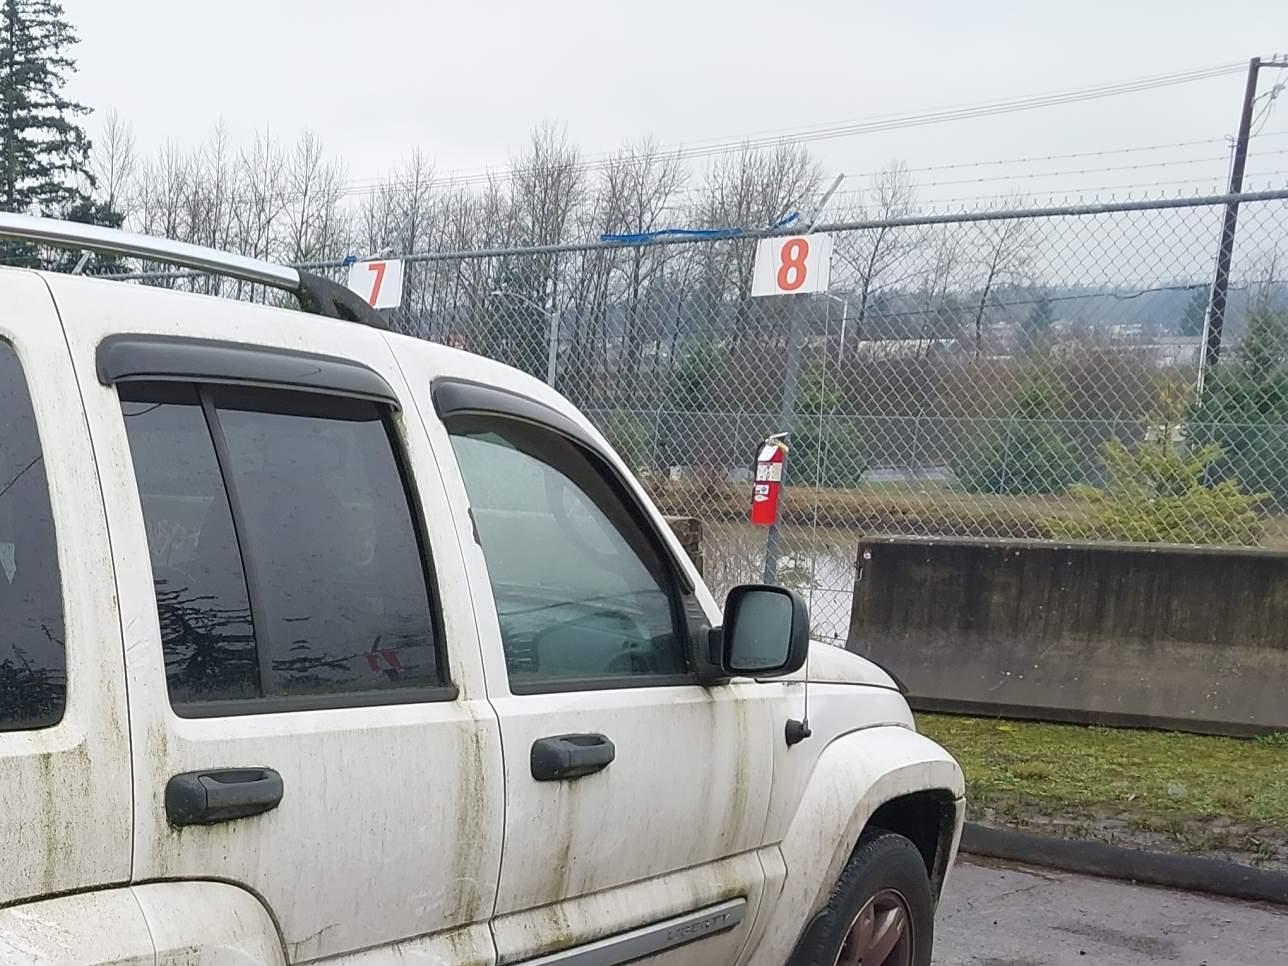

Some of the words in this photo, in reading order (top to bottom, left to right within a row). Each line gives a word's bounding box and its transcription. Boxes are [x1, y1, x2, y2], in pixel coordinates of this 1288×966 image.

[368, 263, 386, 306] 7
[777, 238, 809, 291] 8
[666, 913, 730, 940] LIBERTY
